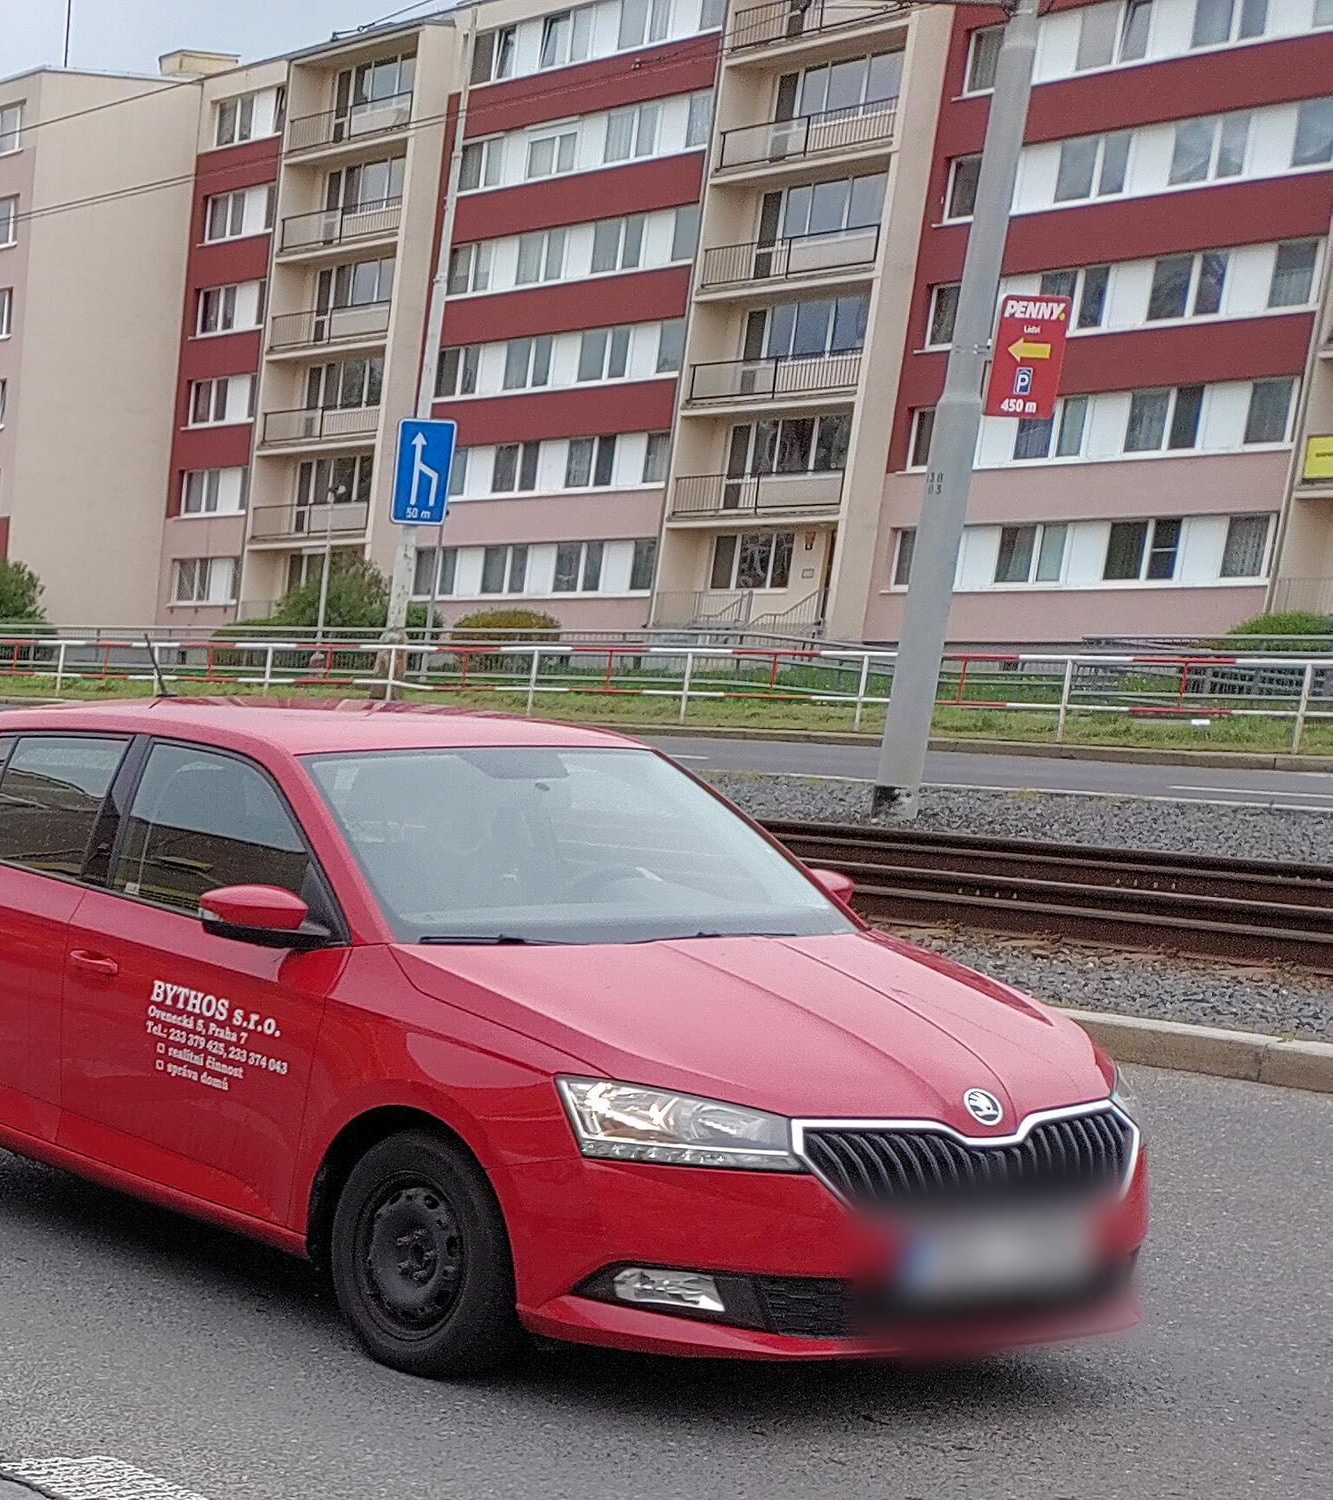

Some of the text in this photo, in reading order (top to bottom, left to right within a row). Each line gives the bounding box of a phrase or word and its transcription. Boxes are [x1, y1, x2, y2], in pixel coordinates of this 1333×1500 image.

[1001, 398, 1037, 413] 450 m
[406, 507, 431, 519] 50 m
[150, 980, 281, 1038] BYTHOS s.r.o.
[145, 1020, 167, 1039] Tel.:
[167, 1027, 187, 1044] 233
[187, 1033, 206, 1049] 379
[227, 1046, 247, 1063] 233
[247, 1052, 267, 1069] 374
[207, 1022, 238, 1042] Praha
[239, 1031, 248, 1045] 7
